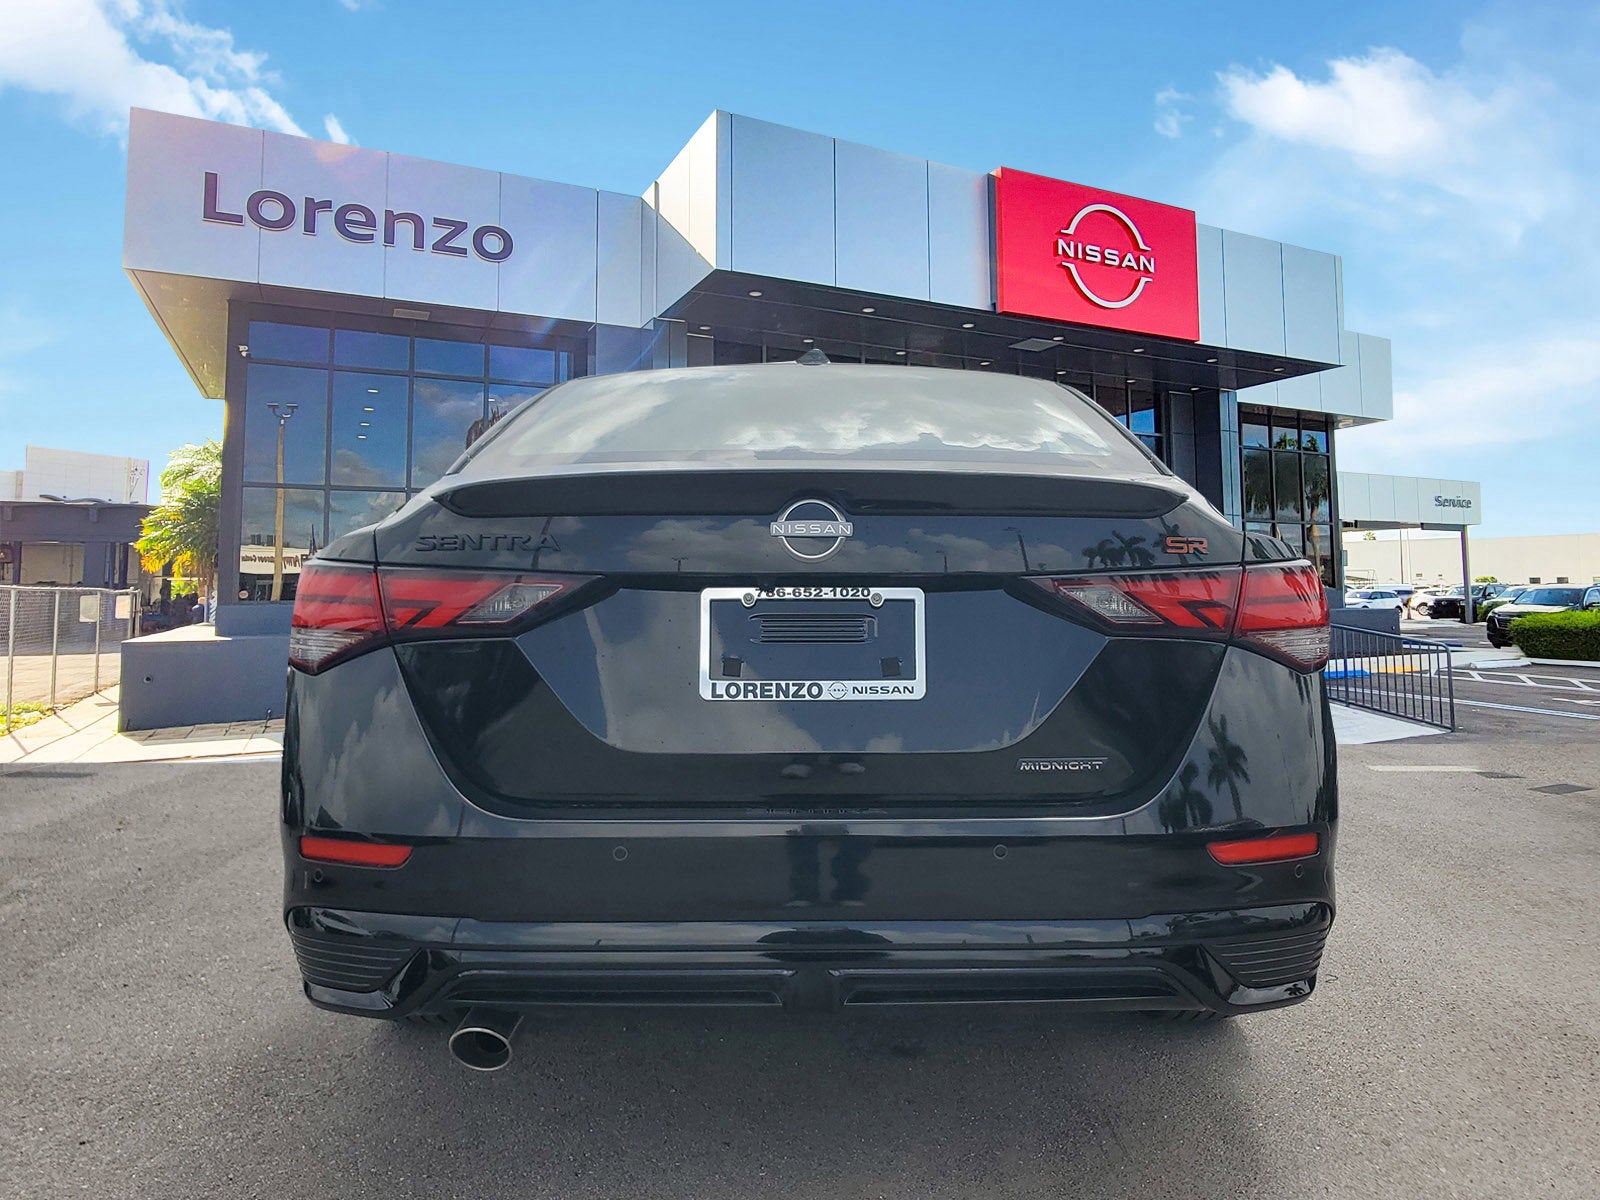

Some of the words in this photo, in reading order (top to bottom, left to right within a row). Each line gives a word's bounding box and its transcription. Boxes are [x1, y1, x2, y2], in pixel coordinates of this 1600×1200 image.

[202, 171, 514, 262] Lorenzo
[1057, 238, 1155, 273] NISSAN
[1434, 495, 1472, 509] Service
[772, 523, 851, 535] NISSAN
[415, 533, 562, 552] SENTRA
[1165, 536, 1209, 554] SR
[755, 587, 871, 598] 786-652-1020
[711, 682, 824, 699] LORENZO
[852, 686, 914, 695] NISSAN
[1020, 761, 1104, 771] MIDNIGHT
